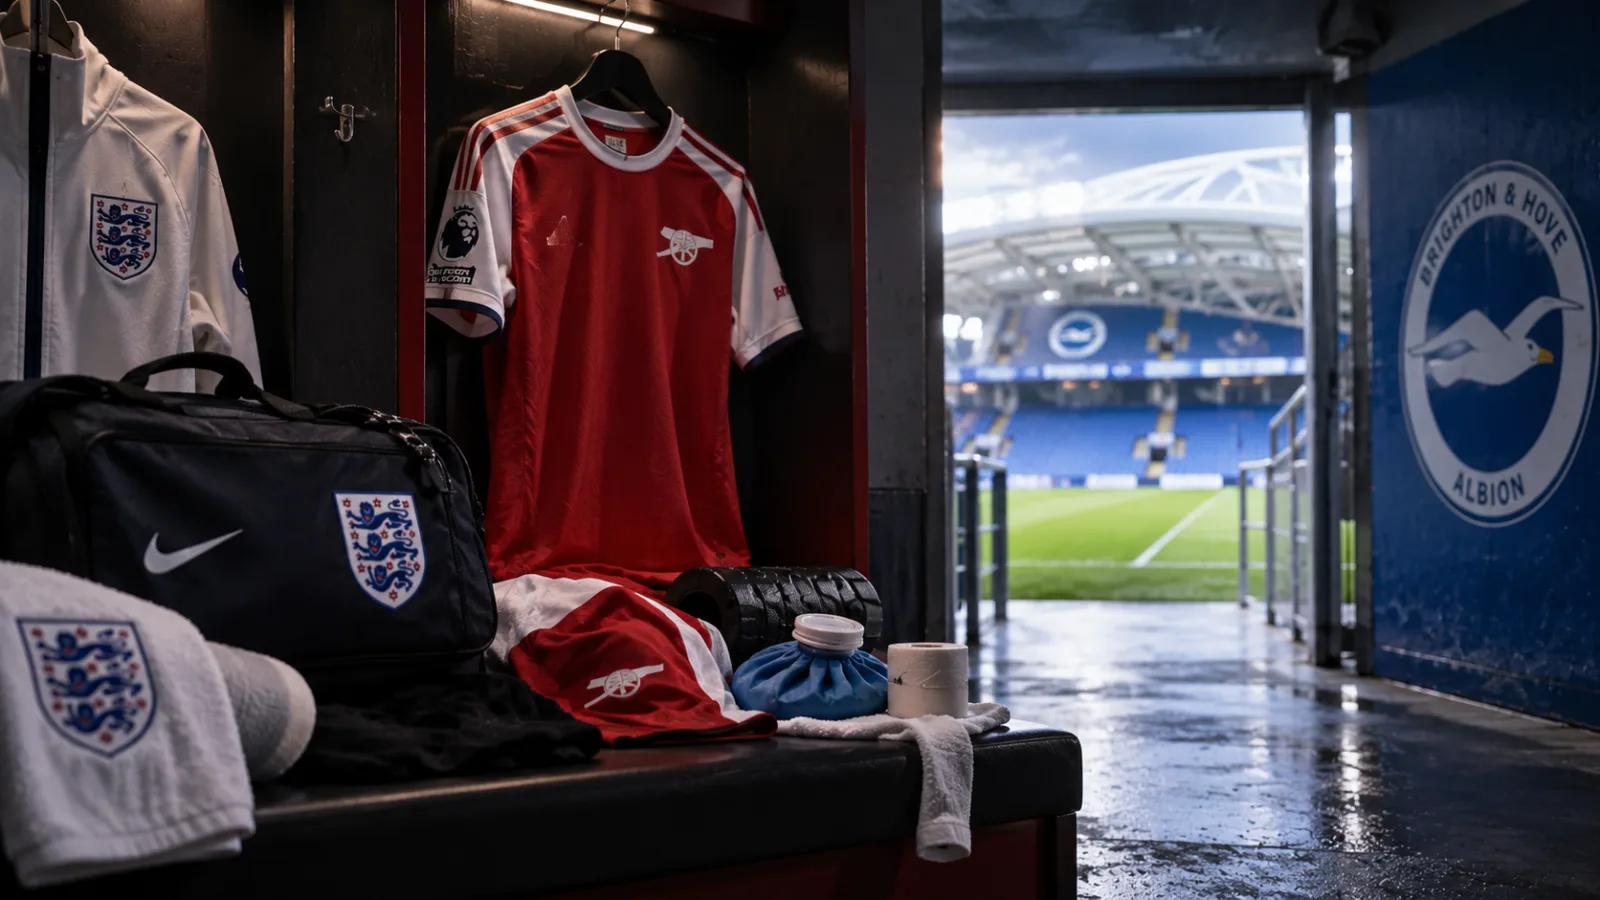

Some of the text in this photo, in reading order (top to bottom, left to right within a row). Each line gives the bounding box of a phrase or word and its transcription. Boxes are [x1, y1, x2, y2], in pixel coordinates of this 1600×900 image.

[1419, 182, 1568, 286] BRIGHTON & HOVE
[1453, 472, 1525, 506] ALBION
